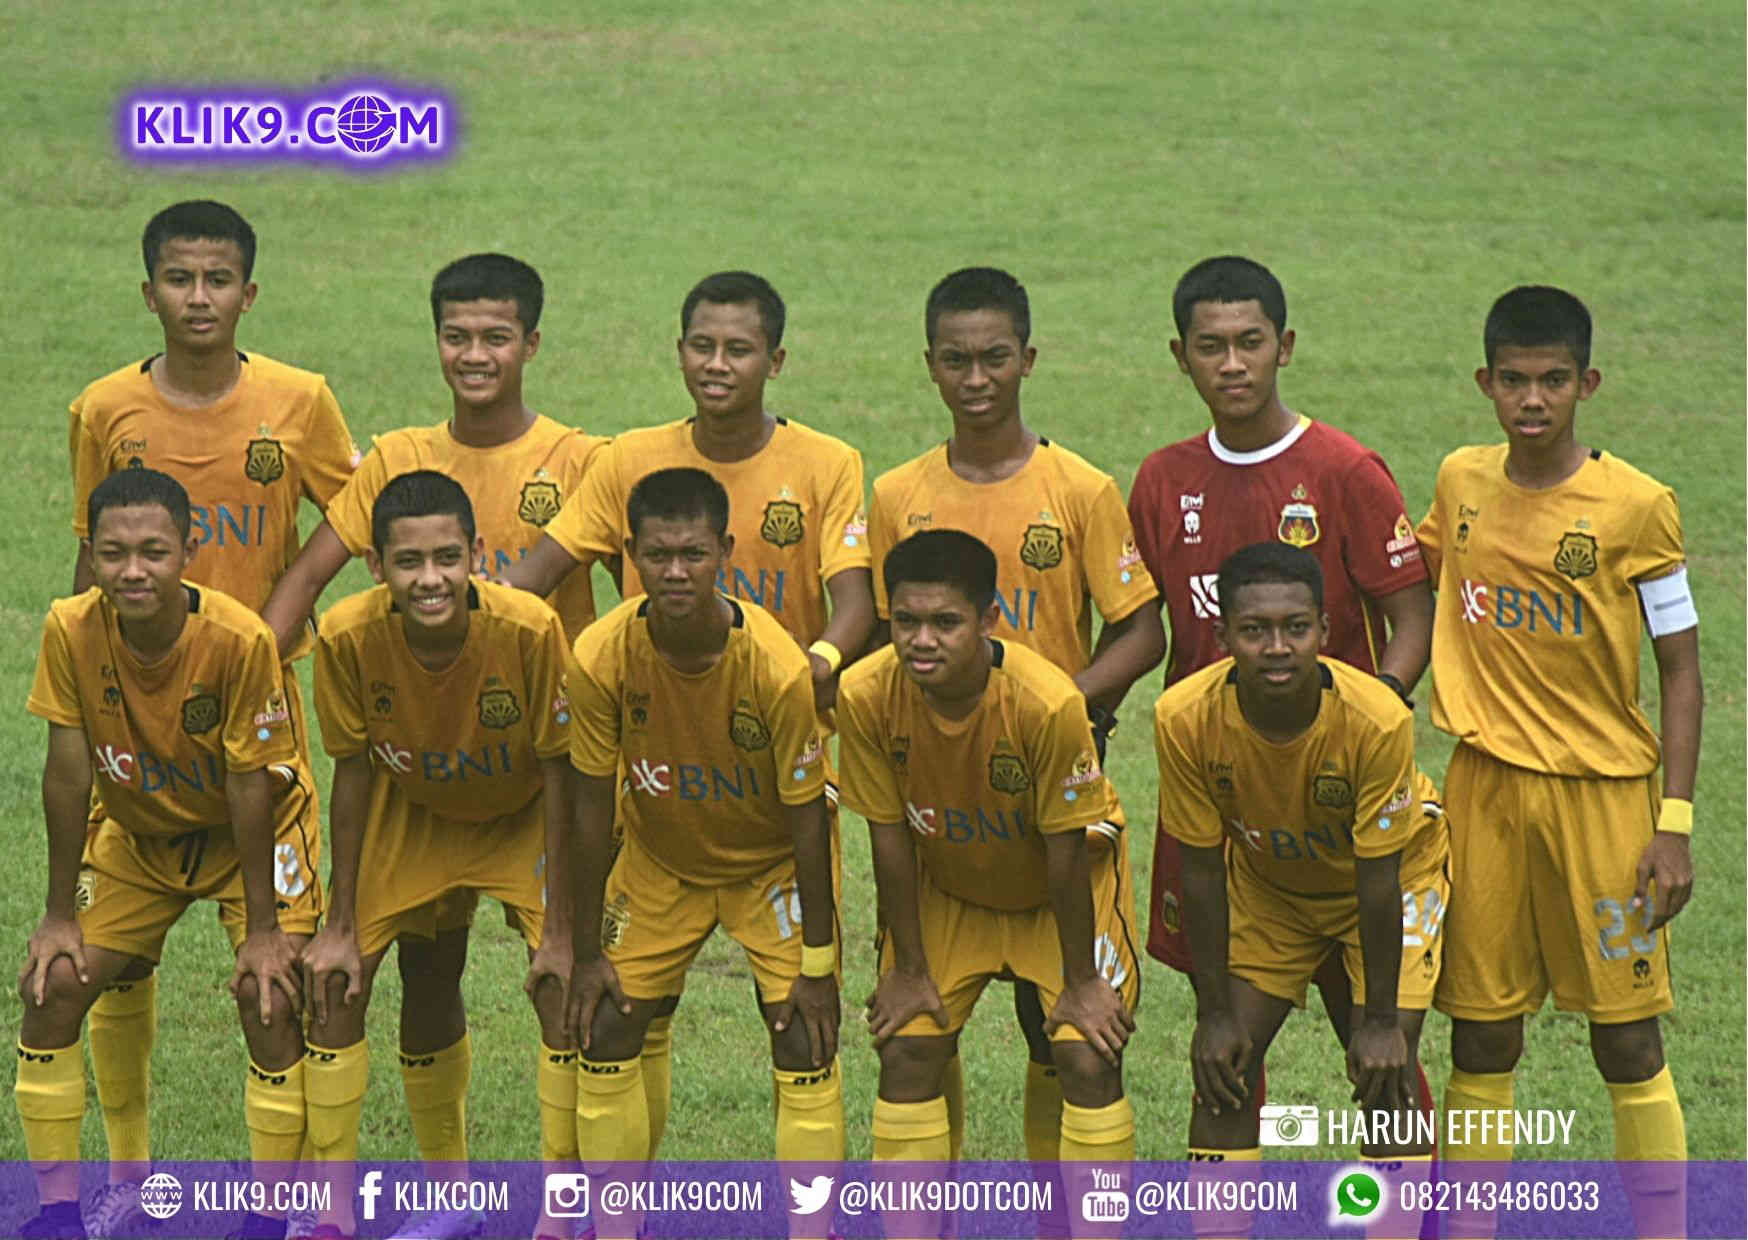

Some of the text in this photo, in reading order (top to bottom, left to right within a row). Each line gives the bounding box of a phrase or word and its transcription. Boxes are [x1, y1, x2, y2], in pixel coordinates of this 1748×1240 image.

[1496, 586, 1582, 635] BNI
[140, 751, 219, 793] BNI
[422, 743, 513, 782] BNI
[679, 763, 761, 800] BNI
[945, 807, 1028, 844] BNI
[1593, 896, 1657, 961] 23
